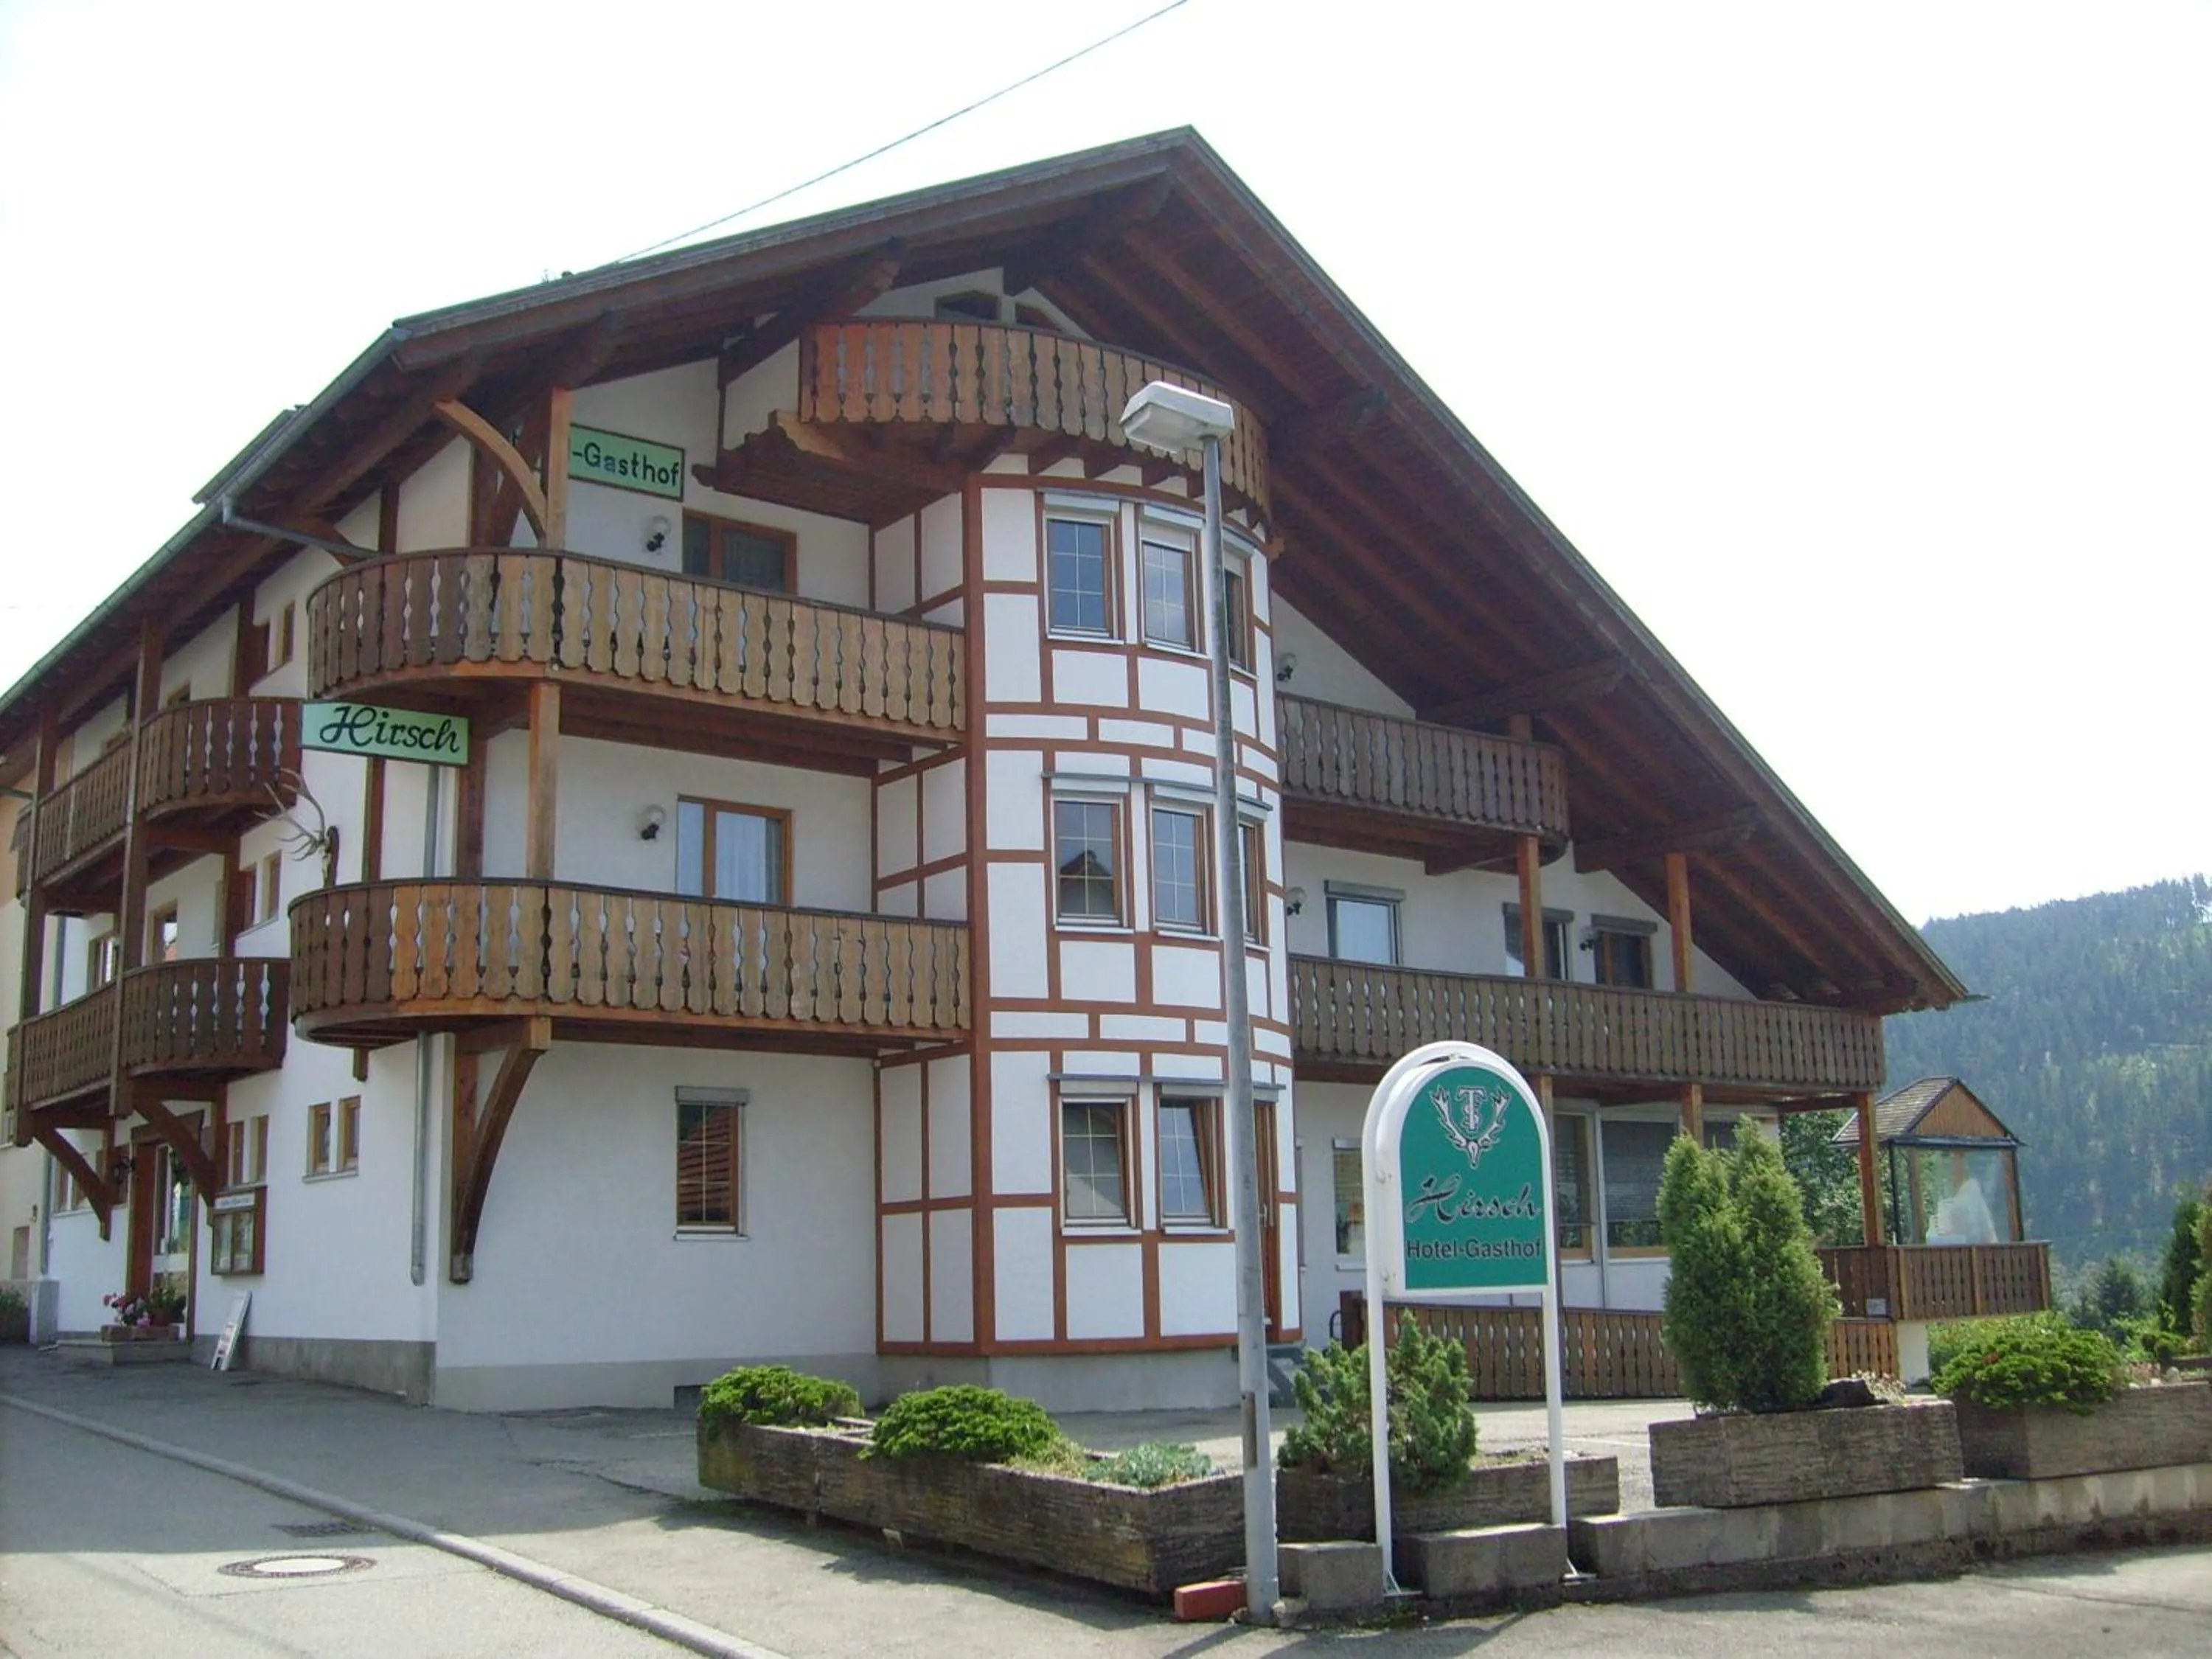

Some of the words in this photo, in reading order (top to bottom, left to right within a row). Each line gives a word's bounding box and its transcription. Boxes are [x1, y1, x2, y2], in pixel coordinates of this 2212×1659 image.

[572, 442, 680, 487] -Gasthof
[319, 705, 460, 754] Hirsch
[1404, 1173, 1542, 1224] Hirsch
[1405, 1237, 1542, 1259] Hotel-Gasthof
